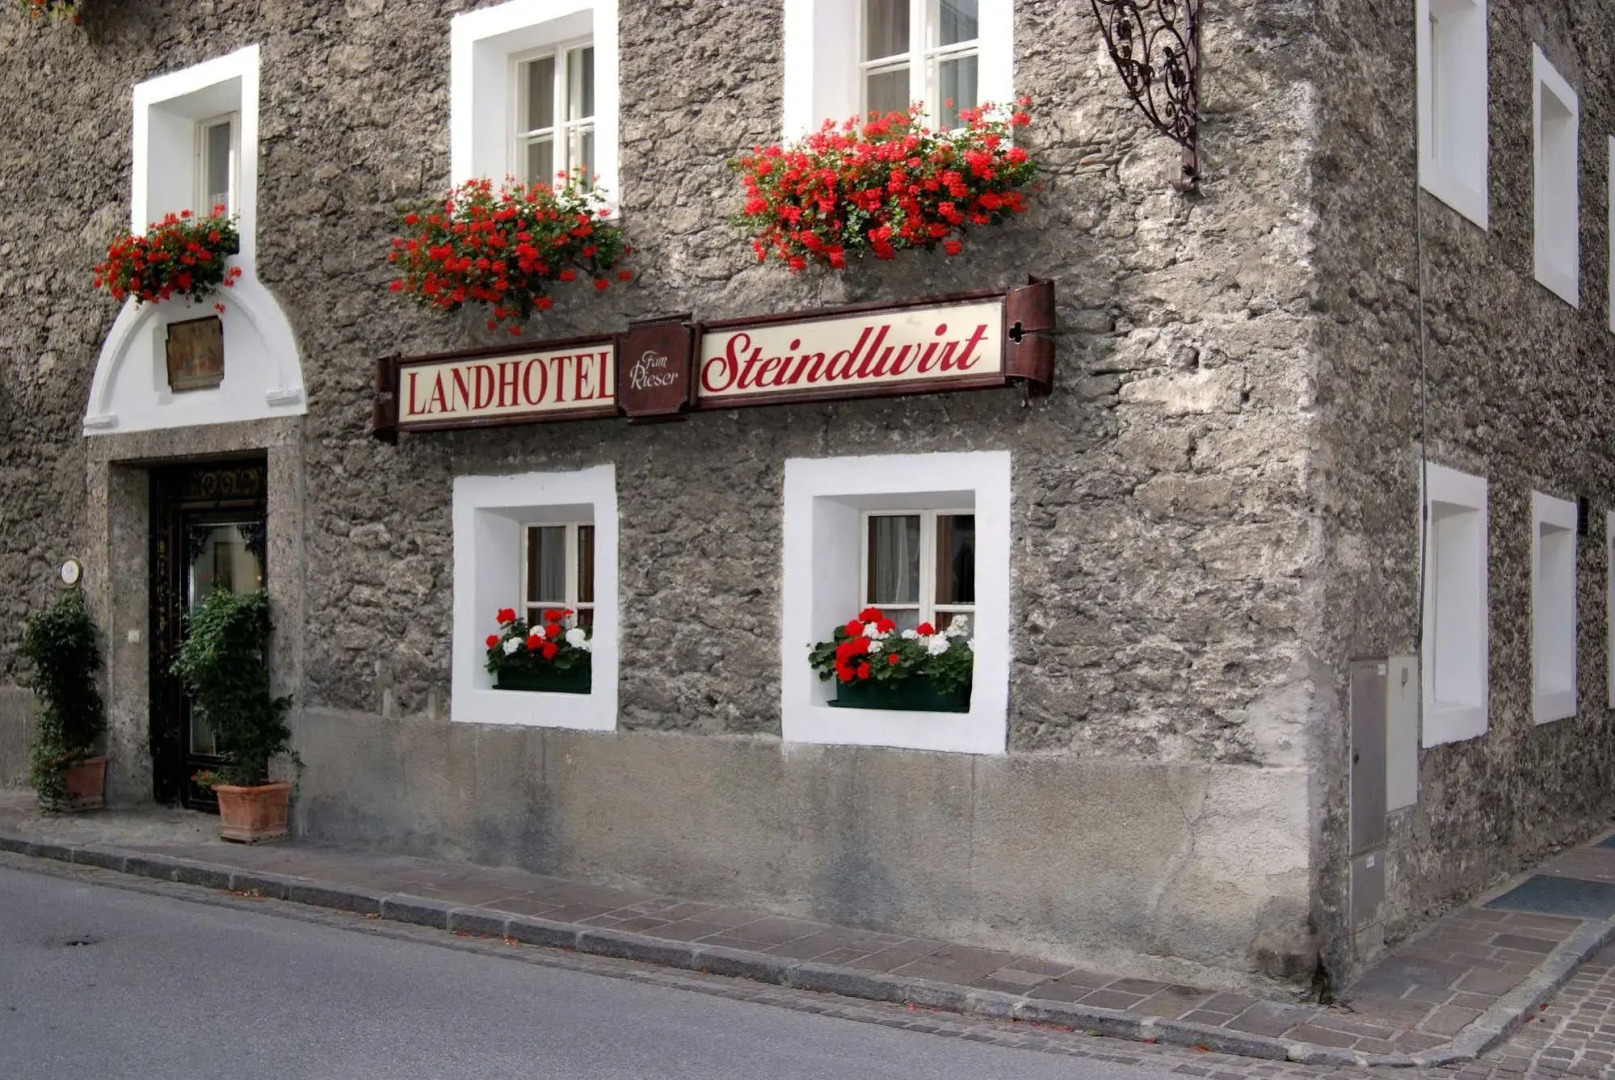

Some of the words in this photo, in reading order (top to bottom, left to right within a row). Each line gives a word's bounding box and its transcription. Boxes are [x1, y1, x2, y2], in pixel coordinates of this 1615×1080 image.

[407, 351, 615, 416] LANDHOTEL
[630, 359, 679, 391] Rieser
[700, 323, 989, 393] Steindlwirt
